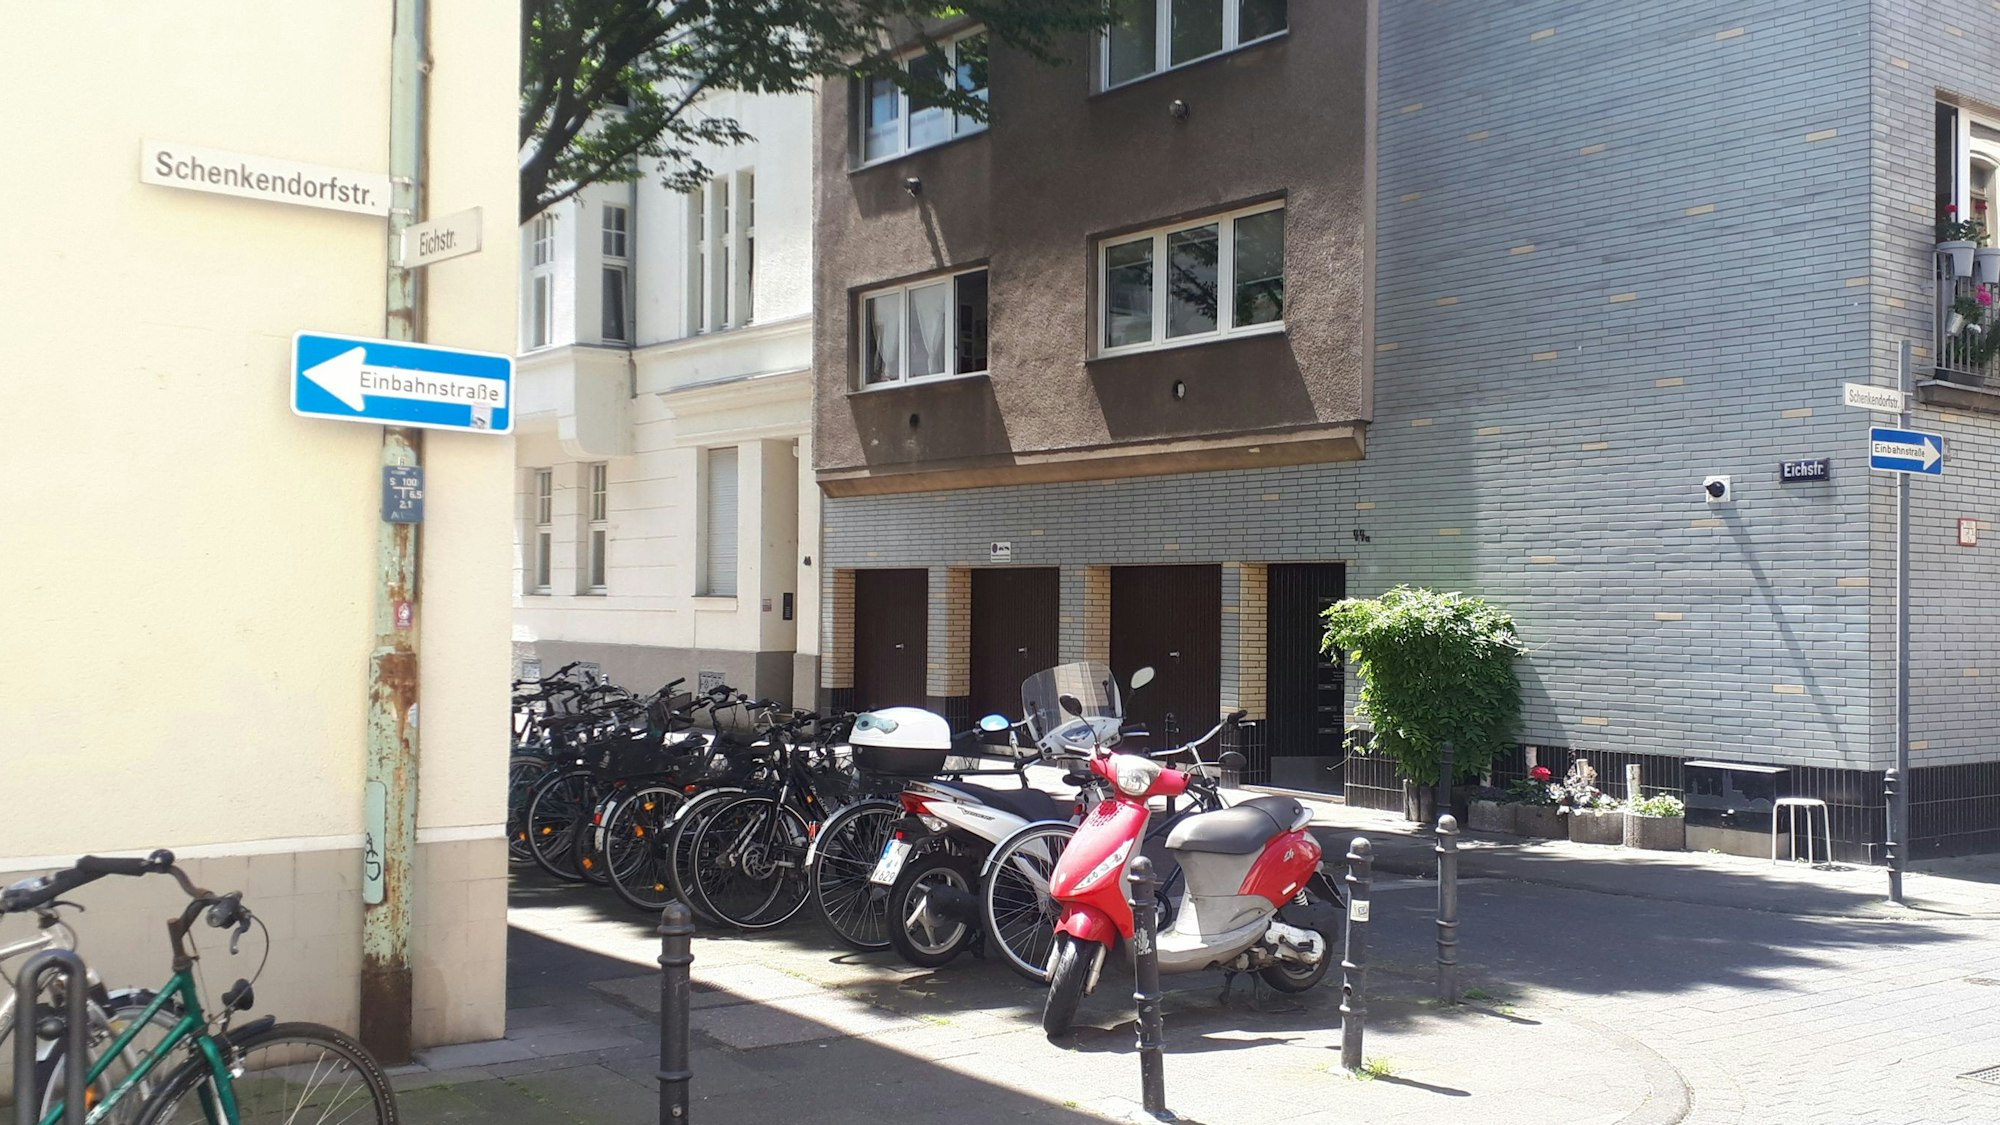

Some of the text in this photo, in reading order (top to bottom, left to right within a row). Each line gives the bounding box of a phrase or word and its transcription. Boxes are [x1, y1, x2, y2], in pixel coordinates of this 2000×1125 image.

[155, 150, 376, 207] Schenkendorfstr.
[419, 227, 457, 257] Eichstr.
[360, 371, 499, 402] Einbahnstraße
[1849, 389, 1900, 409] Schenkendorfstr.
[1874, 443, 1925, 458] Einbahnstraße
[1784, 461, 1825, 477] Eichstr.
